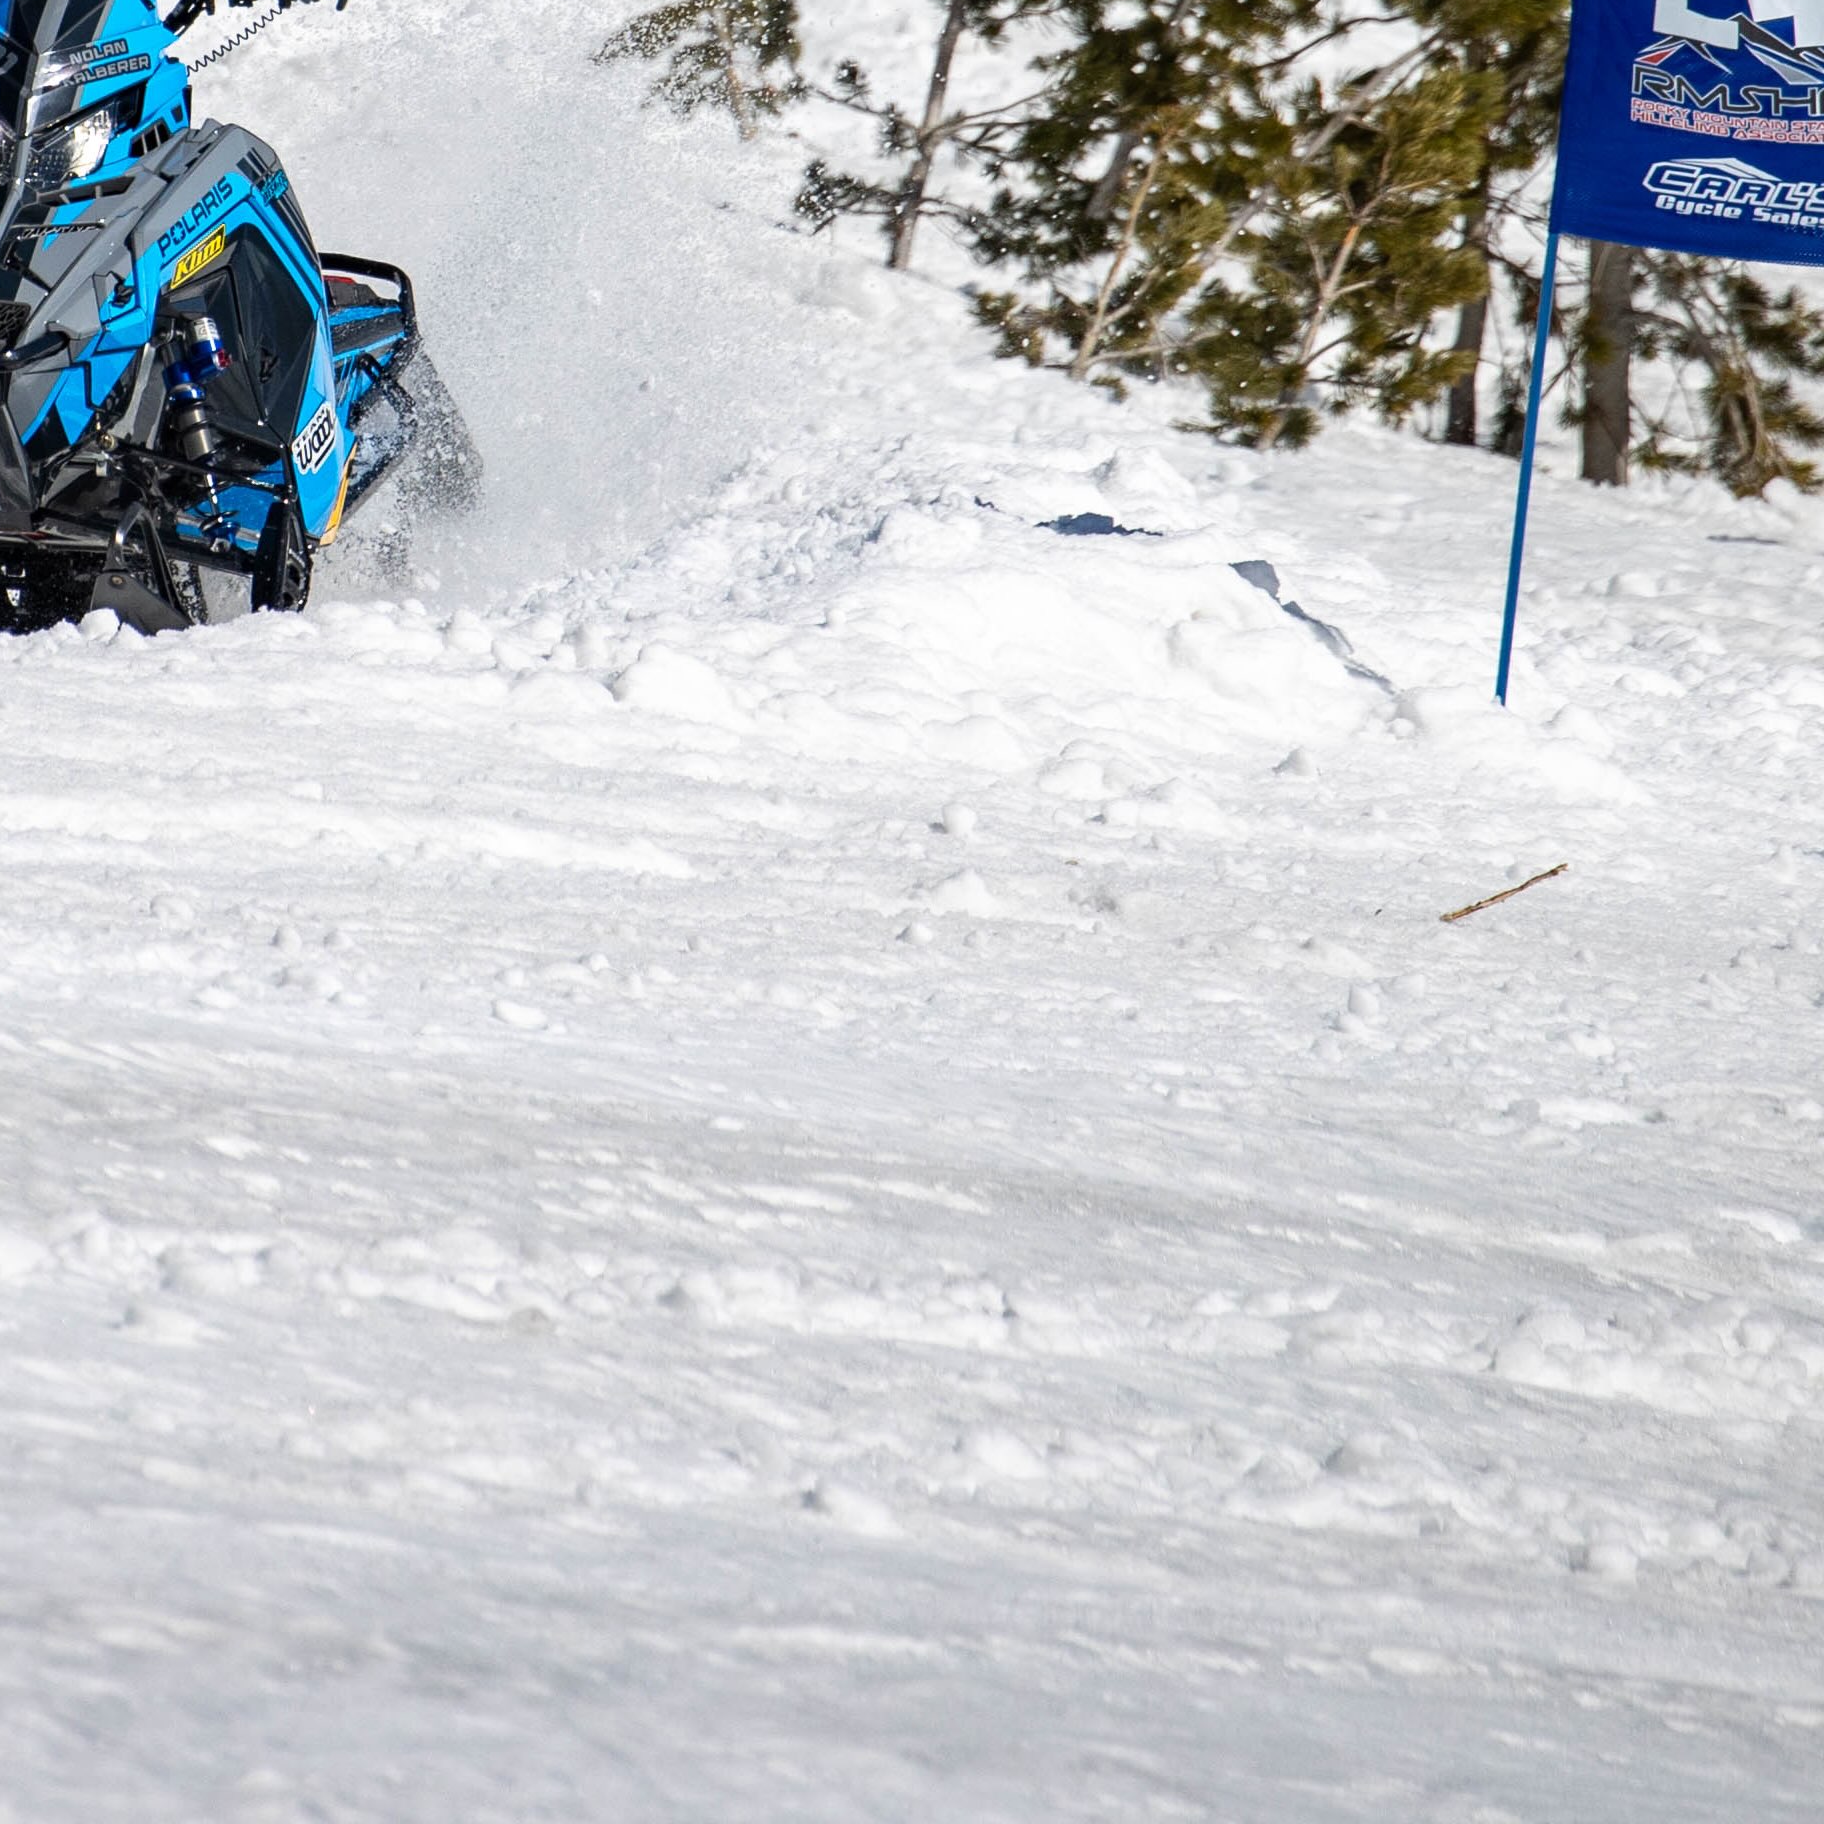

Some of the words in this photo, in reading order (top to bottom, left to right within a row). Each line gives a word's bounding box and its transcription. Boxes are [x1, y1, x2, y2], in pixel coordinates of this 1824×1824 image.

[69, 40, 127, 66] NOLAN
[62, 55, 150, 88] KALBERER
[1632, 64, 1824, 117] RMSH
[1631, 97, 1689, 117] ROCKY
[1693, 110, 1788, 131] MOUNTAIN
[1631, 109, 1729, 138] HILLCLIMB
[157, 177, 233, 257] POLARIS
[1655, 194, 1742, 219] Cycle
